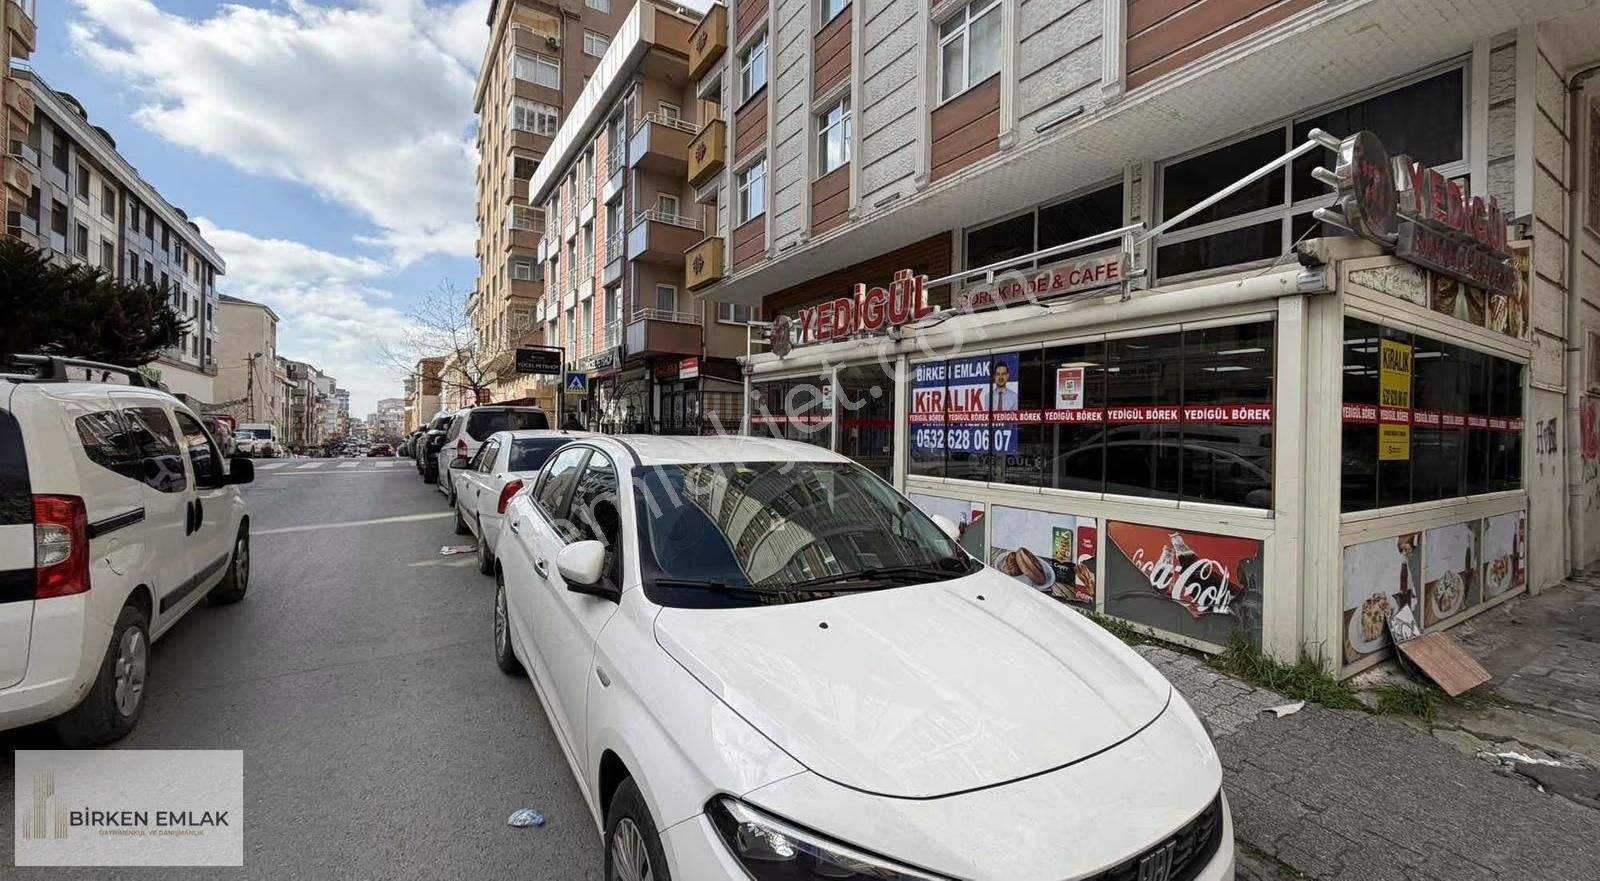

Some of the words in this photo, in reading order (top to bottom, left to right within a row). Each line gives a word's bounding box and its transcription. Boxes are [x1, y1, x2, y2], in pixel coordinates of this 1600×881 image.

[1052, 274, 1063, 289] &
[1069, 262, 1118, 285] CAFE
[799, 269, 938, 344] YEDİGÜL
[954, 361, 991, 379] EMLAK
[993, 412, 1018, 422] YEDİGÜL
[1019, 412, 1041, 421] BÖREK
[1044, 410, 1077, 422] YEDİGÜL
[1079, 410, 1103, 421] BÖREK
[1107, 409, 1145, 421] YEDİGÜL
[1146, 408, 1178, 420] BÖREK
[1184, 407, 1229, 420] YEDİGÜL
[1230, 406, 1271, 420] BÖREK
[916, 428, 944, 450] 0532
[947, 429, 970, 450] 628
[974, 429, 990, 451] 06
[994, 429, 1012, 452] 07
